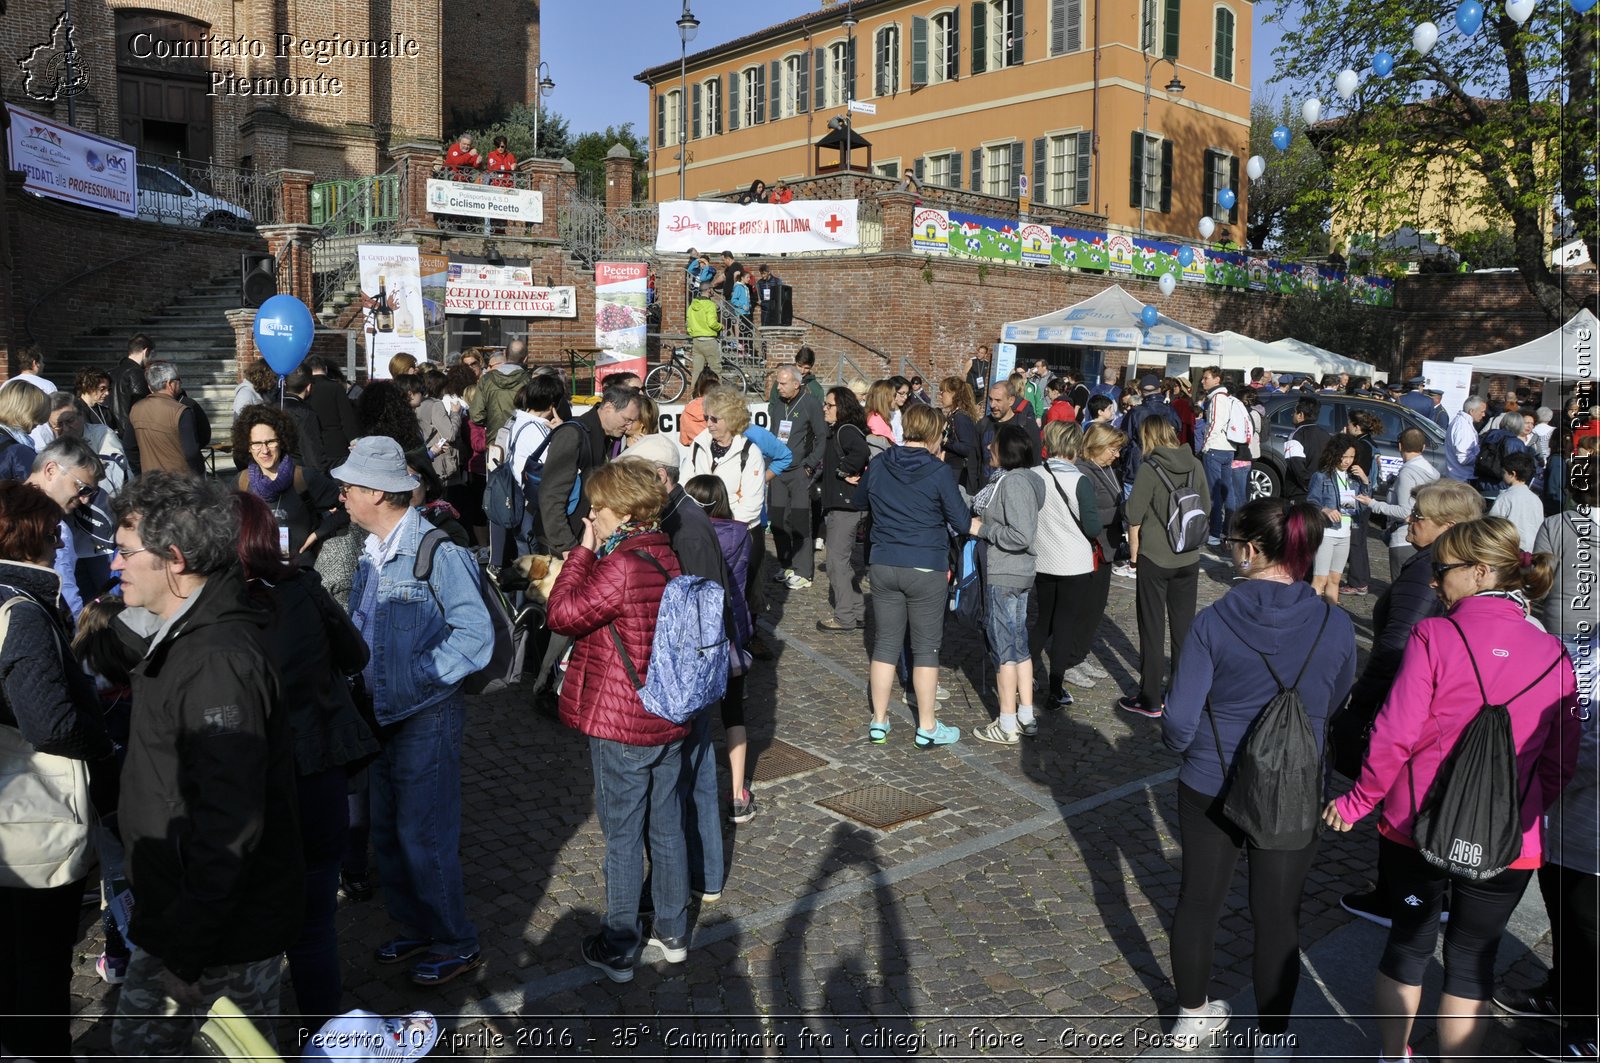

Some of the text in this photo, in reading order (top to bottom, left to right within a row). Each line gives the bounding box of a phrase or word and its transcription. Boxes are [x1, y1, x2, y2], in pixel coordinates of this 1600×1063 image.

[40, 145, 48, 154] di
[17, 162, 54, 184] AFFIDATI
[55, 174, 67, 188] alla
[459, 192, 491, 202] Polisportiva
[450, 198, 520, 213] Ciclismo Pecetto
[672, 215, 691, 229] 30
[707, 221, 737, 236] CROCE
[739, 220, 769, 235] ROSSA
[772, 218, 810, 234] ITALIANA
[914, 210, 947, 230] TAPPOROSSO
[603, 265, 640, 276] Pecetto
[445, 287, 550, 300] ECETTO TORINESE
[444, 300, 555, 311] PAESE DELLE CILIEGE
[1449, 838, 1483, 867] ABC
